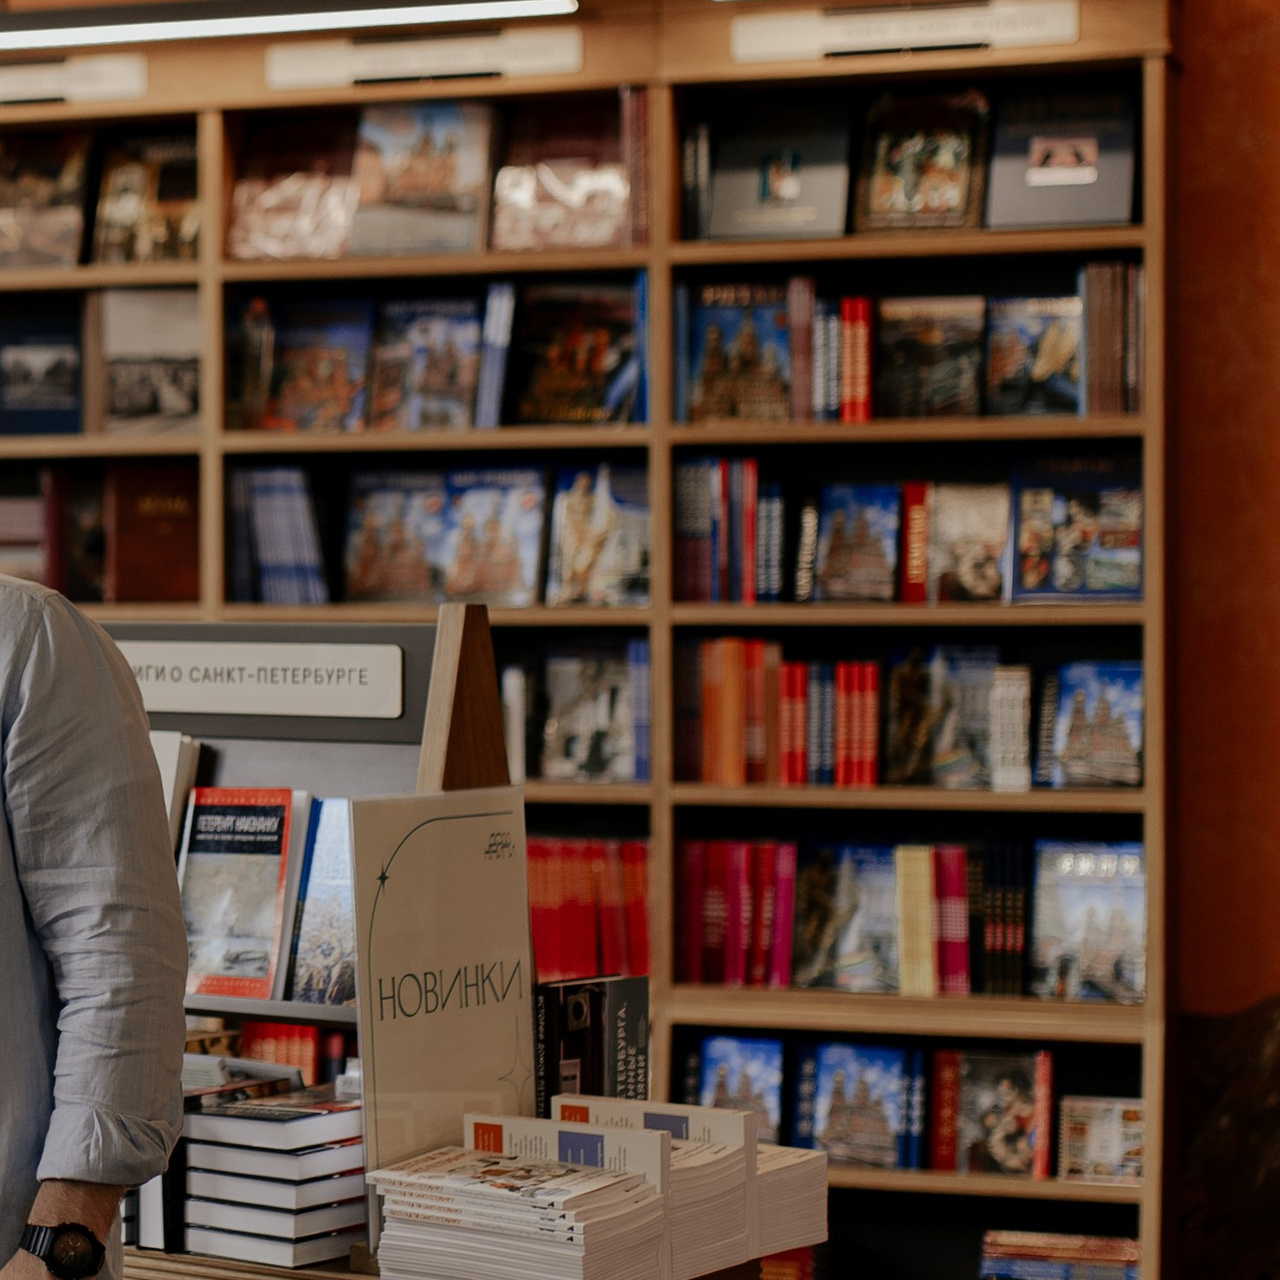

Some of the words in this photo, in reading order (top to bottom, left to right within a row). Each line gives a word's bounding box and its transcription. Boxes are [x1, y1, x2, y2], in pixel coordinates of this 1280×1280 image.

[171, 666, 183, 683] О
[189, 666, 369, 686] САНКТ-ПЕТЕРБУРГЕ
[378, 960, 522, 1021] НОВИНКИ
